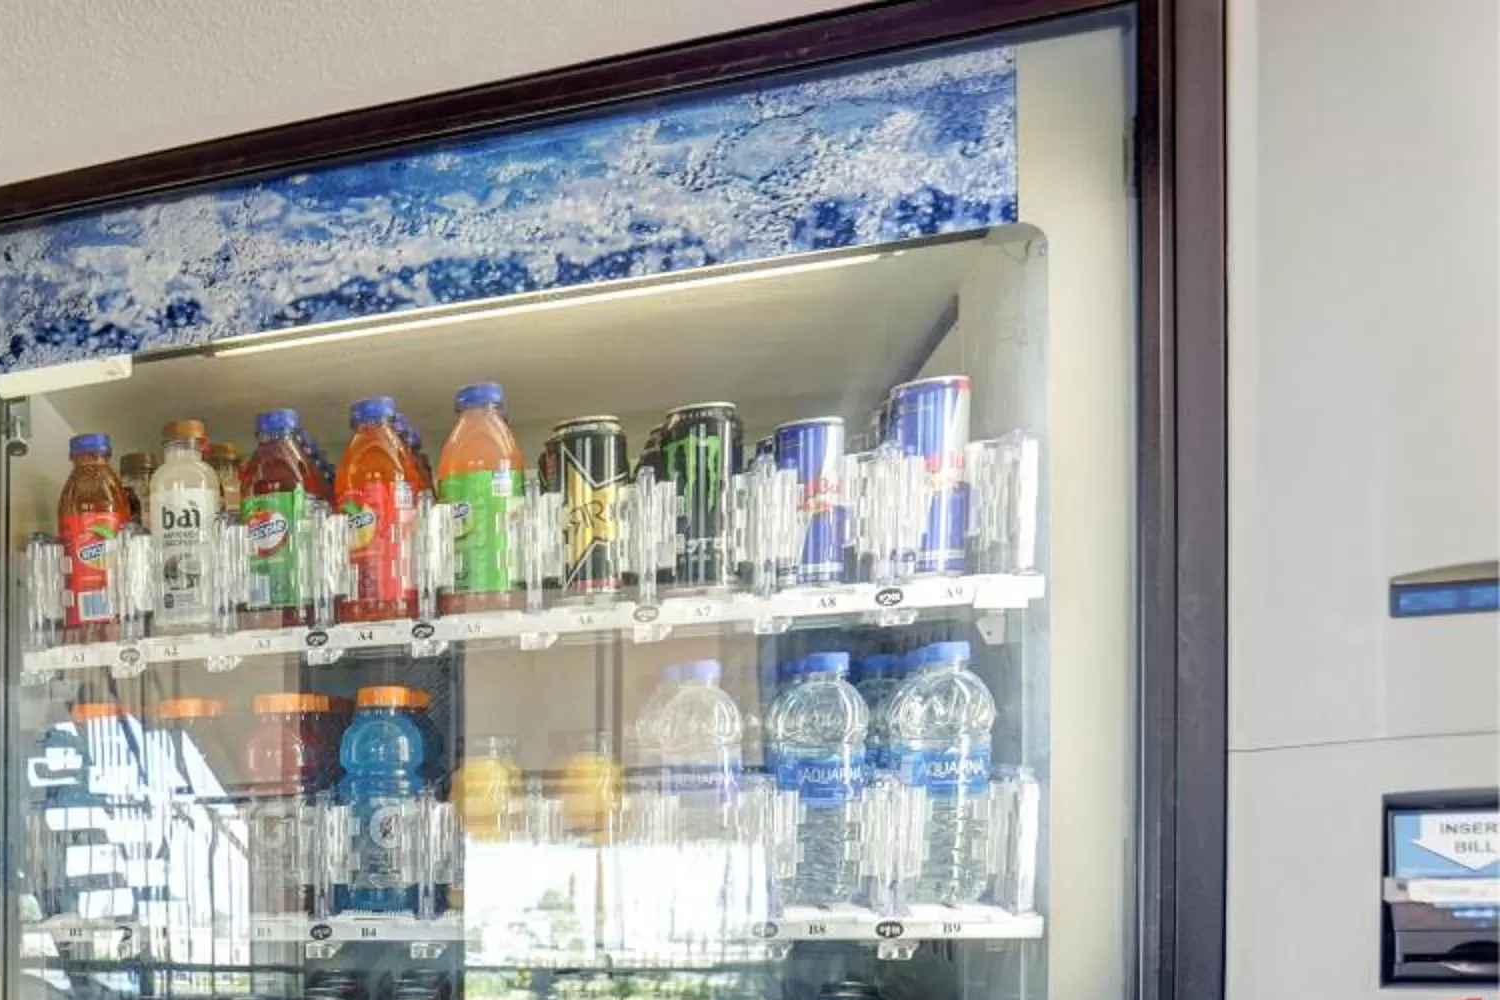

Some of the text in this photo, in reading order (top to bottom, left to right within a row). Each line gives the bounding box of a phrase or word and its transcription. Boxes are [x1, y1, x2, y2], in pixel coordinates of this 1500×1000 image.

[162, 500, 201, 529] bai
[358, 631, 374, 641] A4
[1441, 823, 1500, 834] INSER
[1455, 842, 1495, 853] BILL
